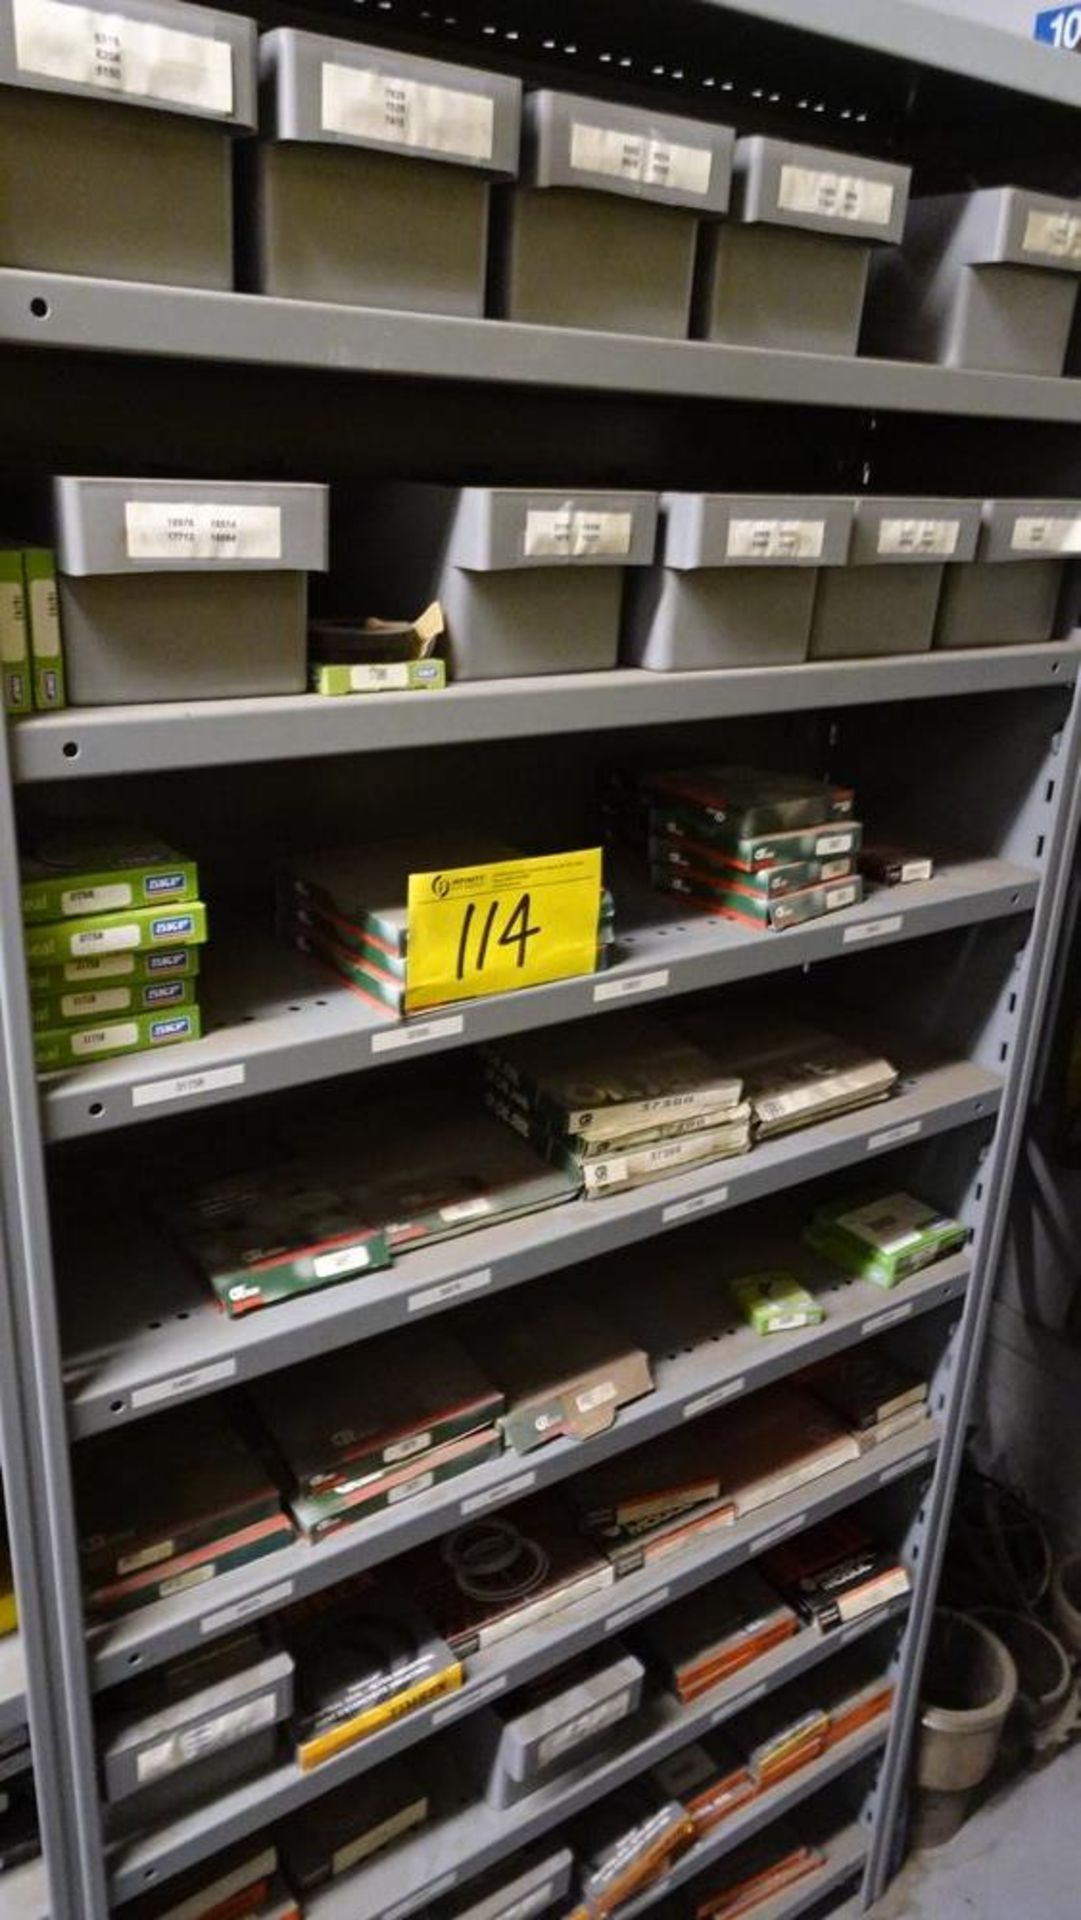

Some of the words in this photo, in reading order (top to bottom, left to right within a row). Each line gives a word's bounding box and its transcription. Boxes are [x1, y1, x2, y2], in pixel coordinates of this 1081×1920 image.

[148, 876, 183, 890] SKF
[154, 917, 190, 935] SKF
[455, 892, 542, 981] 114
[150, 954, 185, 969] SKF
[147, 982, 182, 999] SKF
[152, 1019, 187, 1036] SKF
